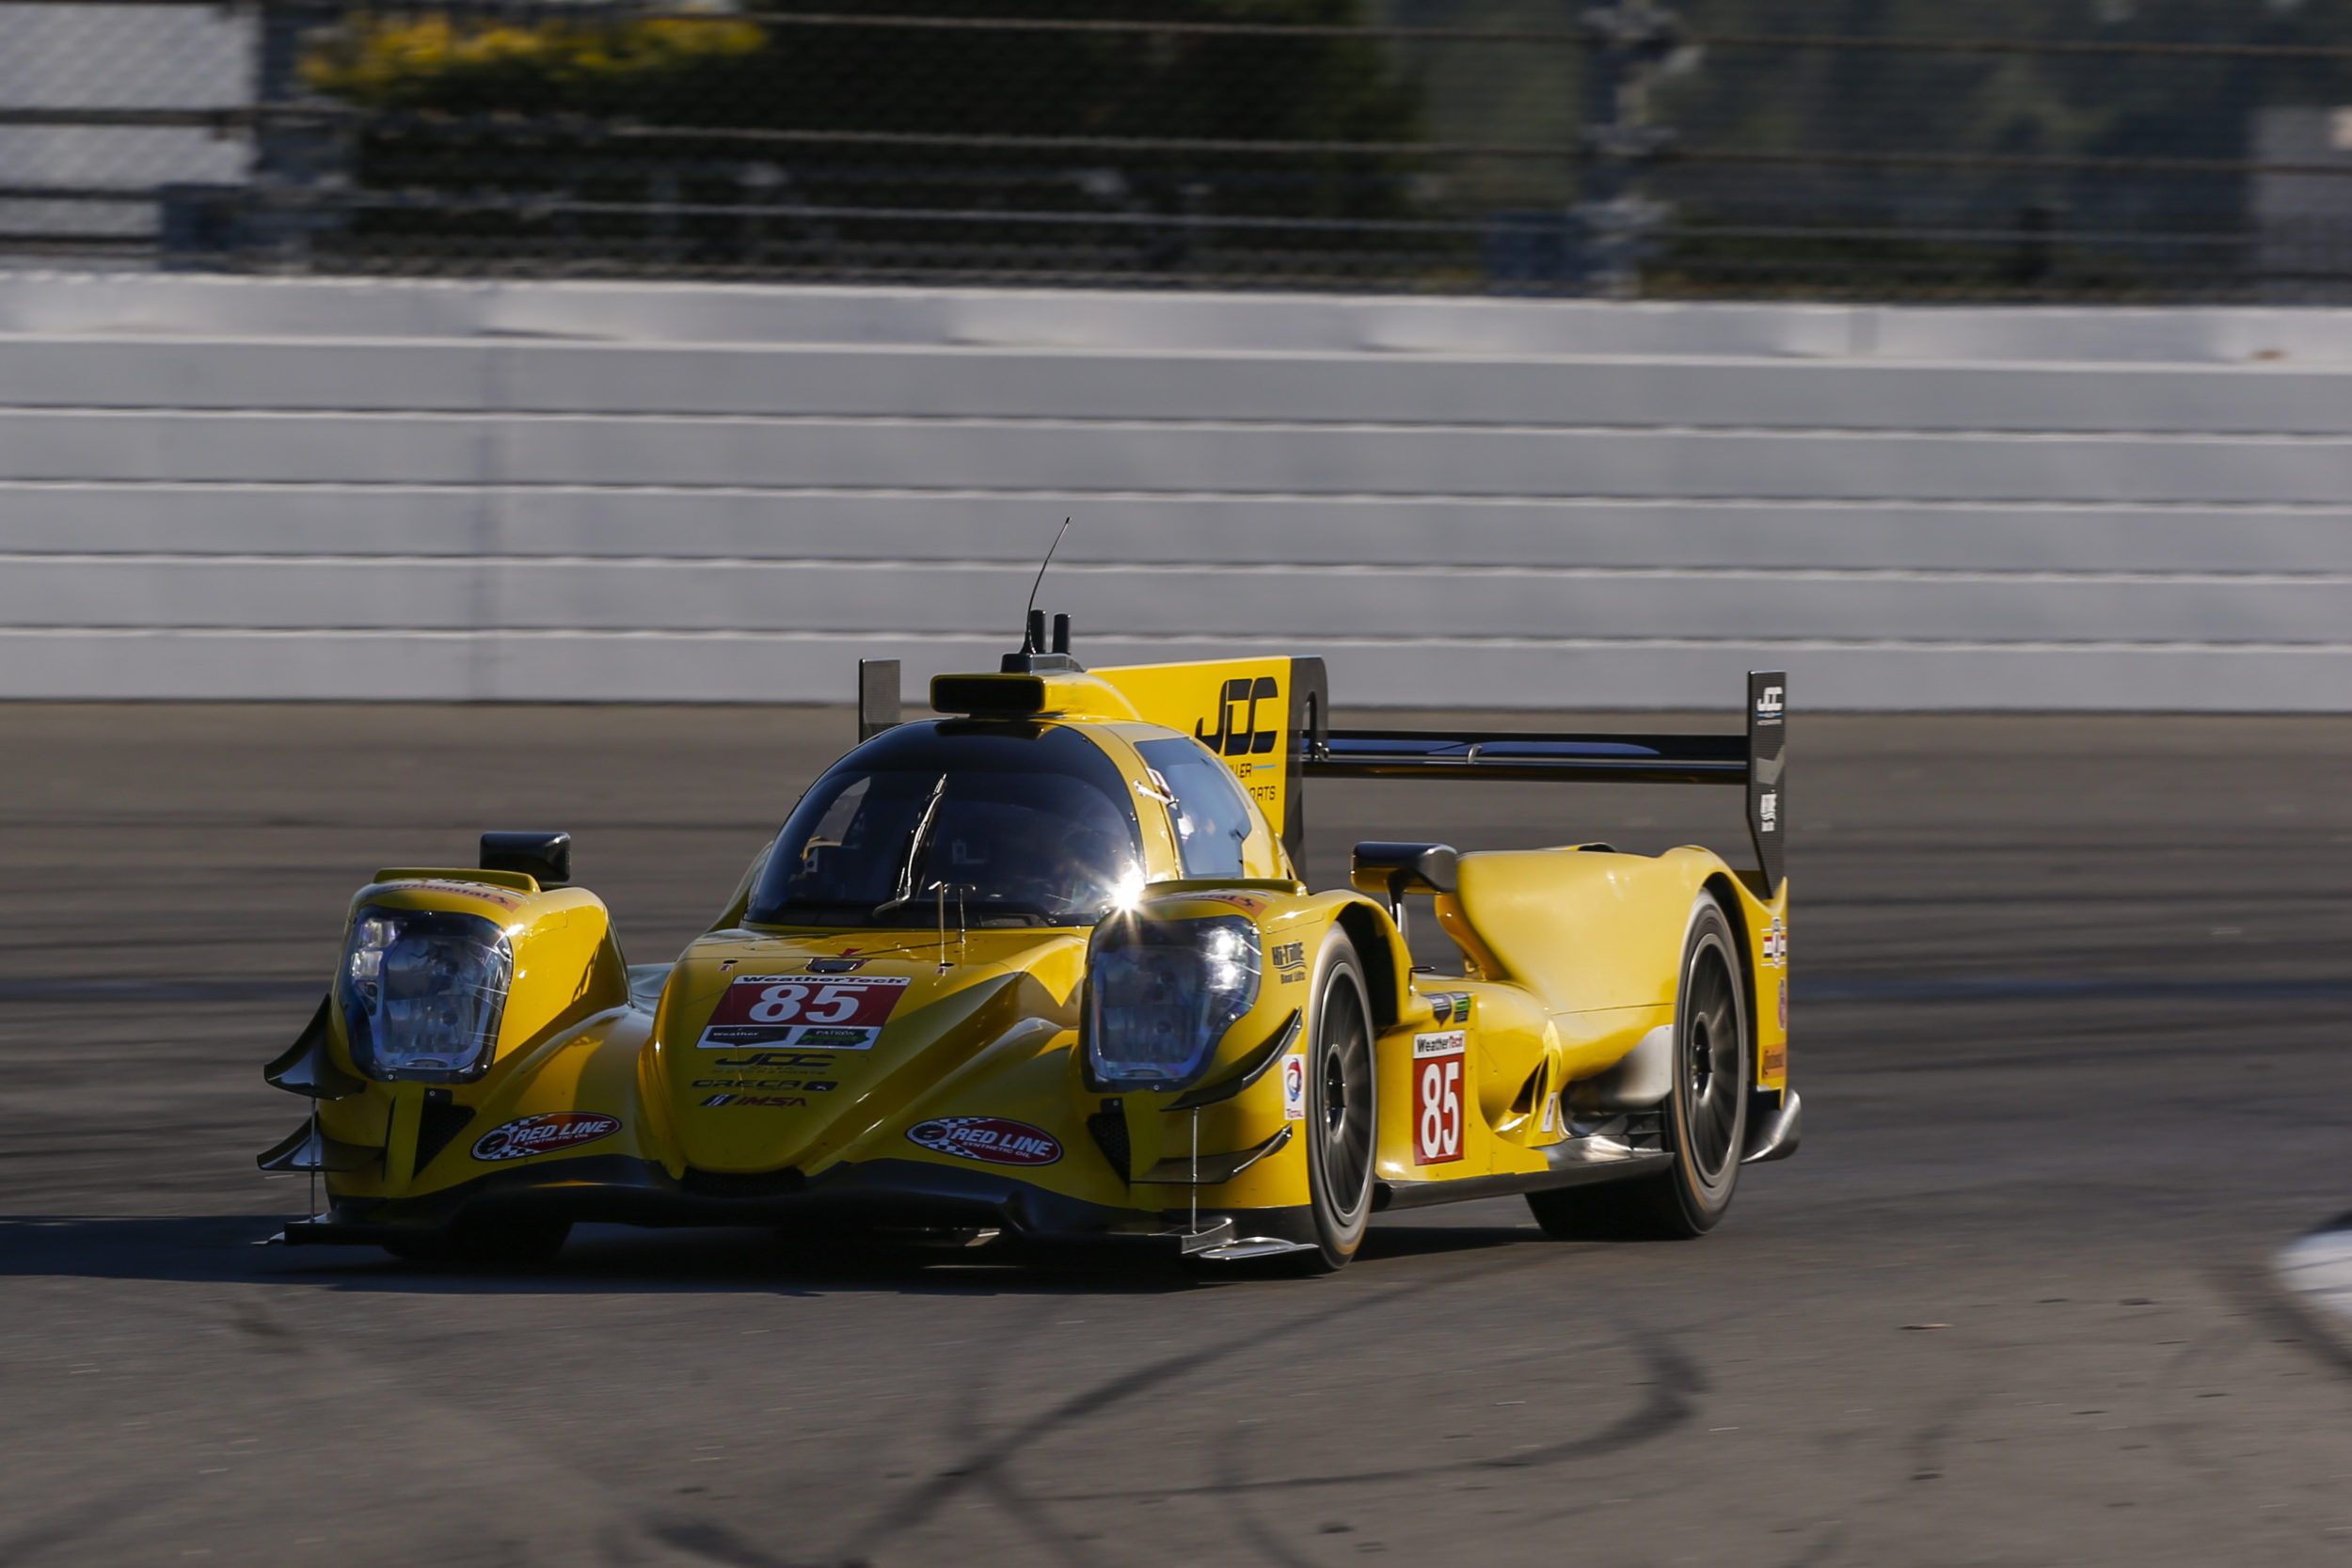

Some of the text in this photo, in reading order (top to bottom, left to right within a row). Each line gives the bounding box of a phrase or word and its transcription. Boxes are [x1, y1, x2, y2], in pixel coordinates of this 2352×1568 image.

[742, 975, 906, 985] WeatherTech
[749, 984, 868, 1023] 85
[1417, 1036, 1463, 1053] WeatherTech
[691, 1079, 799, 1088] ORECA
[734, 1096, 807, 1107] IMSA
[1422, 1061, 1459, 1159] 85
[513, 1120, 612, 1144] RED LINE
[950, 1128, 1053, 1156] RED LINE
[961, 1141, 1012, 1154] SYNTHETIC
